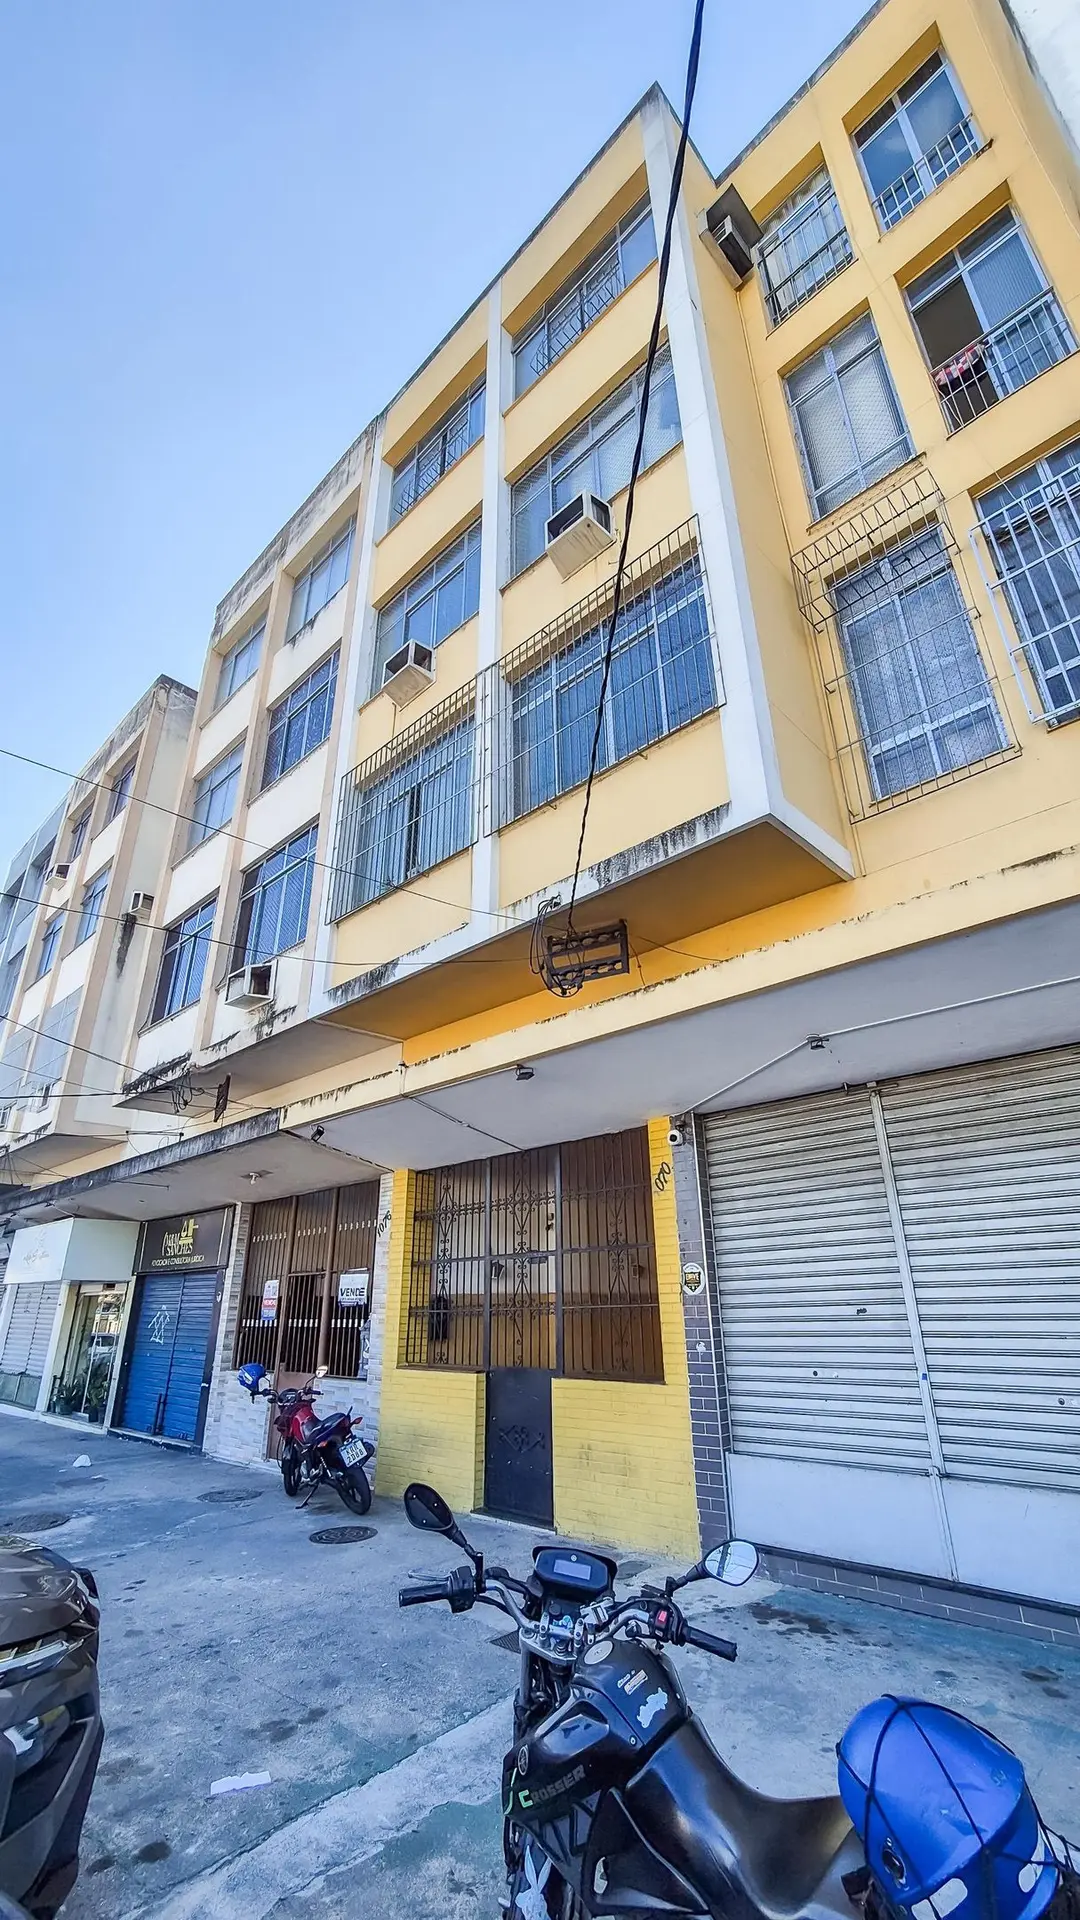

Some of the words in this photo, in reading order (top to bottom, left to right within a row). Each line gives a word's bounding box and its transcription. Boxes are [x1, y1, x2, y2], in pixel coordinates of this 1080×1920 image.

[377, 1210, 392, 1238] 1076
[340, 1287, 365, 1297] VENDE
[518, 1764, 586, 1808] CROSSER
